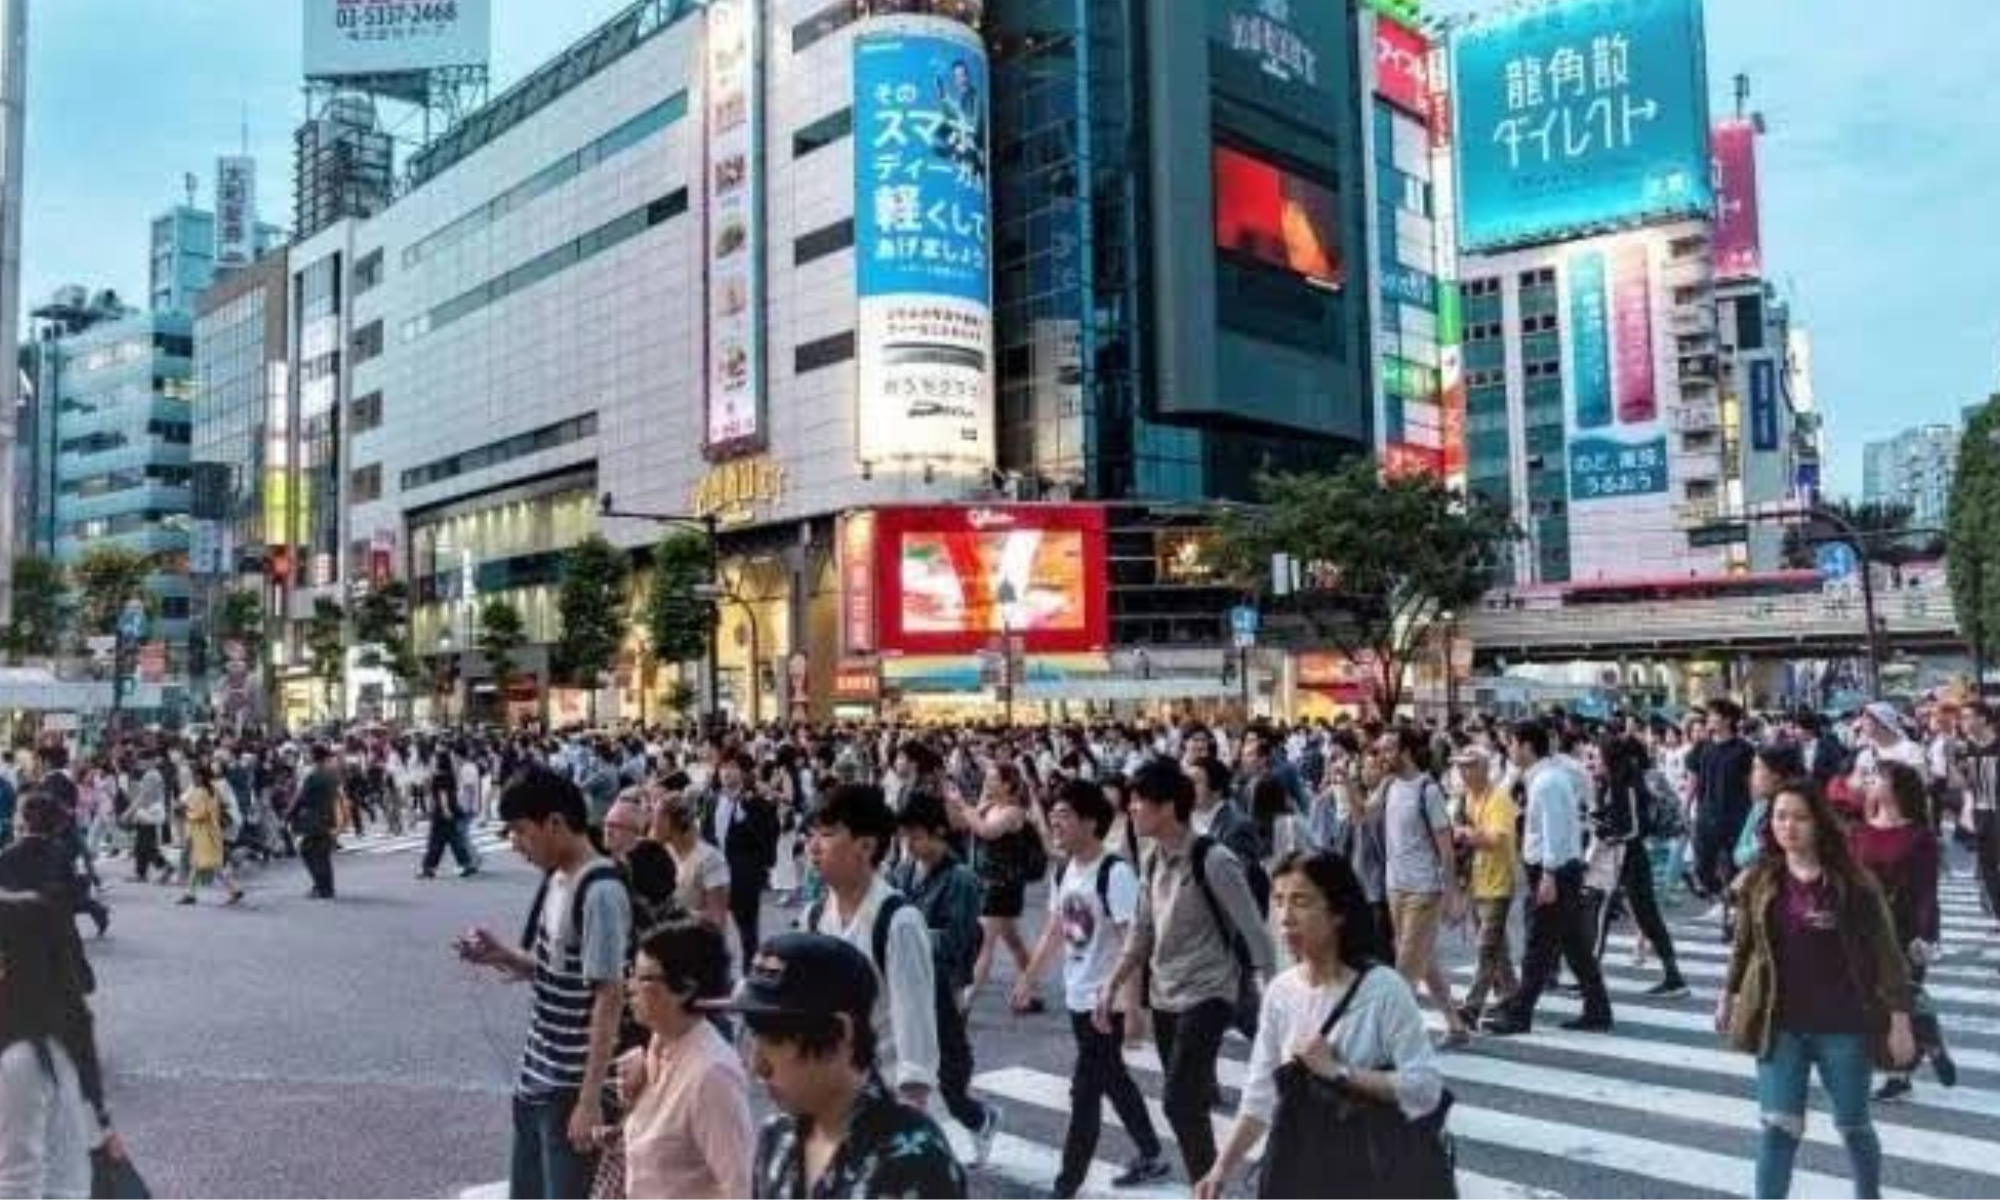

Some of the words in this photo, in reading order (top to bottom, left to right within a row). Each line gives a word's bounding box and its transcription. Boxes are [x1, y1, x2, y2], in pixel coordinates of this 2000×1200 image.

[874, 82, 917, 103] その
[1505, 32, 1630, 110] 龍角散
[1493, 95, 1658, 169] ダイレクト
[873, 184, 985, 243] 軽くして
